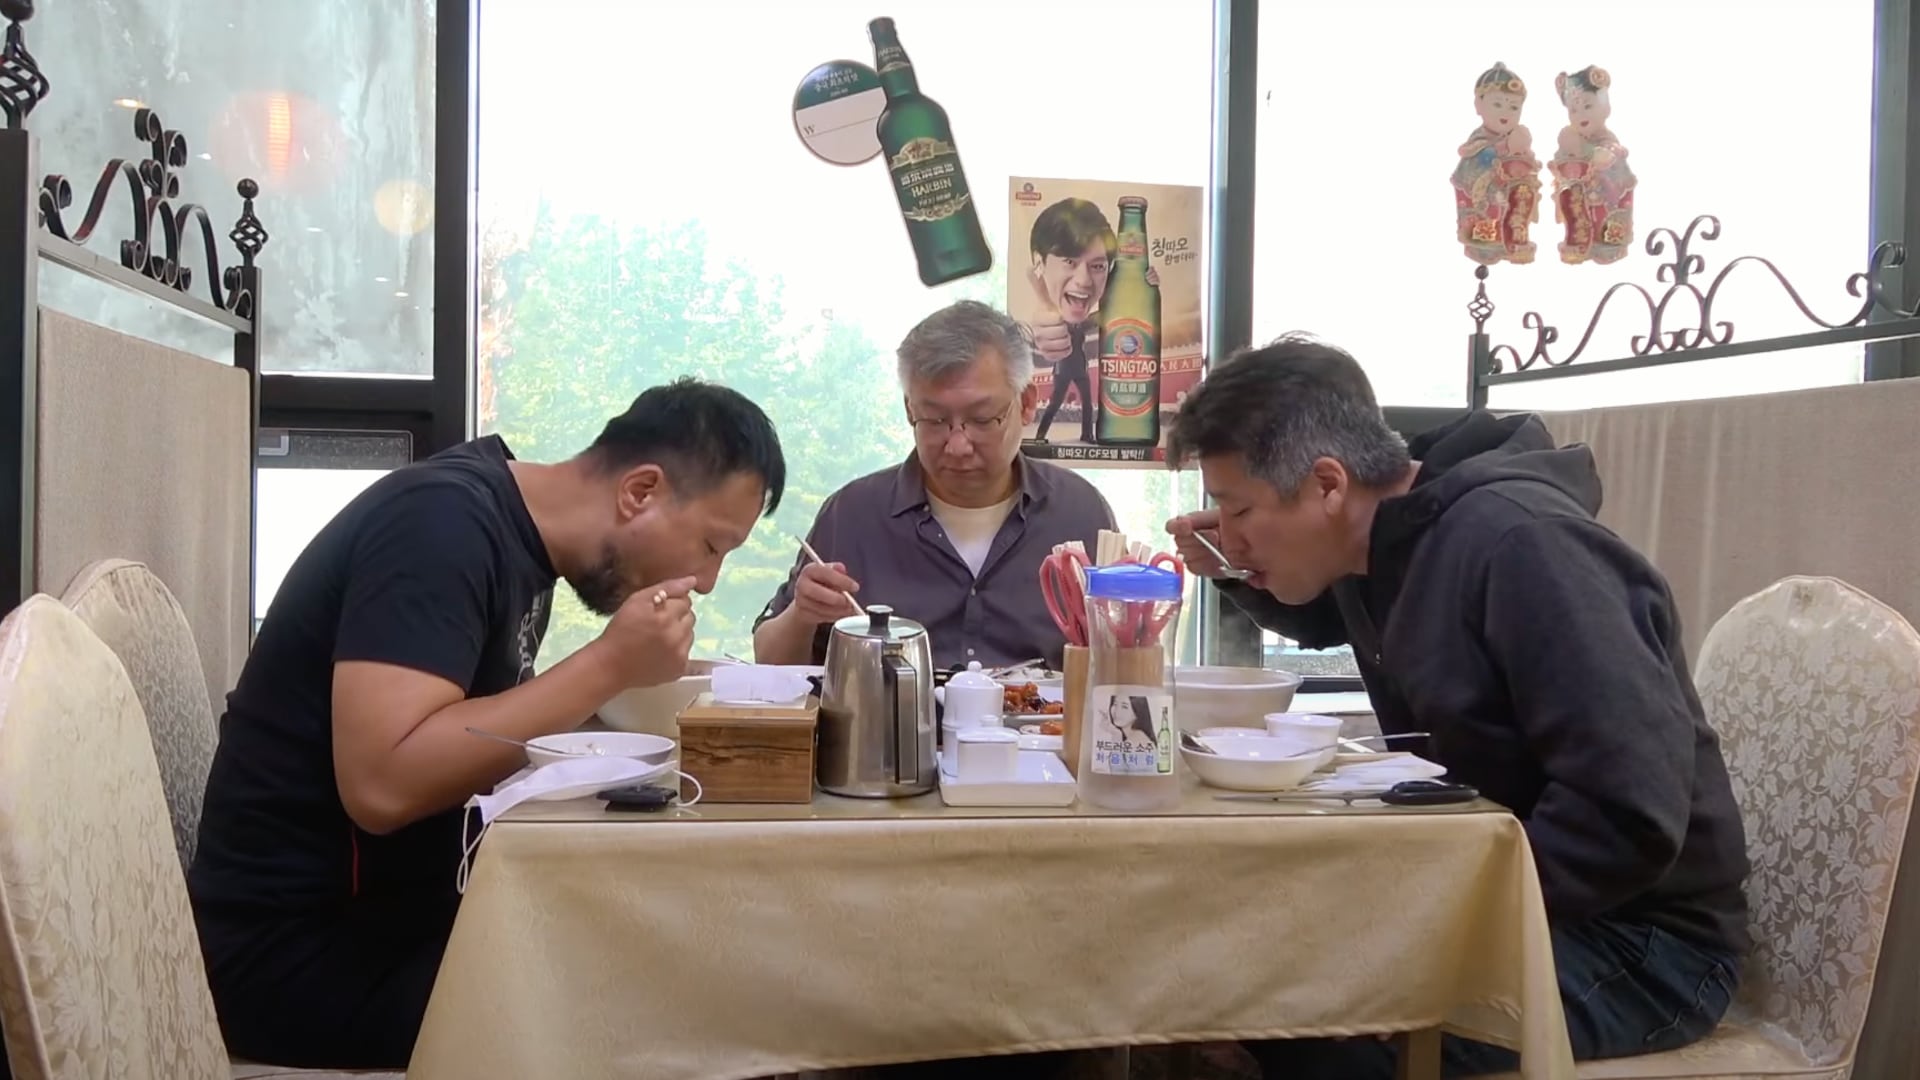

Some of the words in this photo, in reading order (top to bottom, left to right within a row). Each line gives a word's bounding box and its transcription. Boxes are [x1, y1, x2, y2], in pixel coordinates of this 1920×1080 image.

[911, 177, 952, 197] HARBIN
[1151, 237, 1189, 258] 칭따오
[1101, 359, 1157, 374] TSINGTAO
[1089, 448, 1118, 459] CF모델
[1096, 740, 1133, 753] 부드러운
[1135, 742, 1154, 753] 소주
